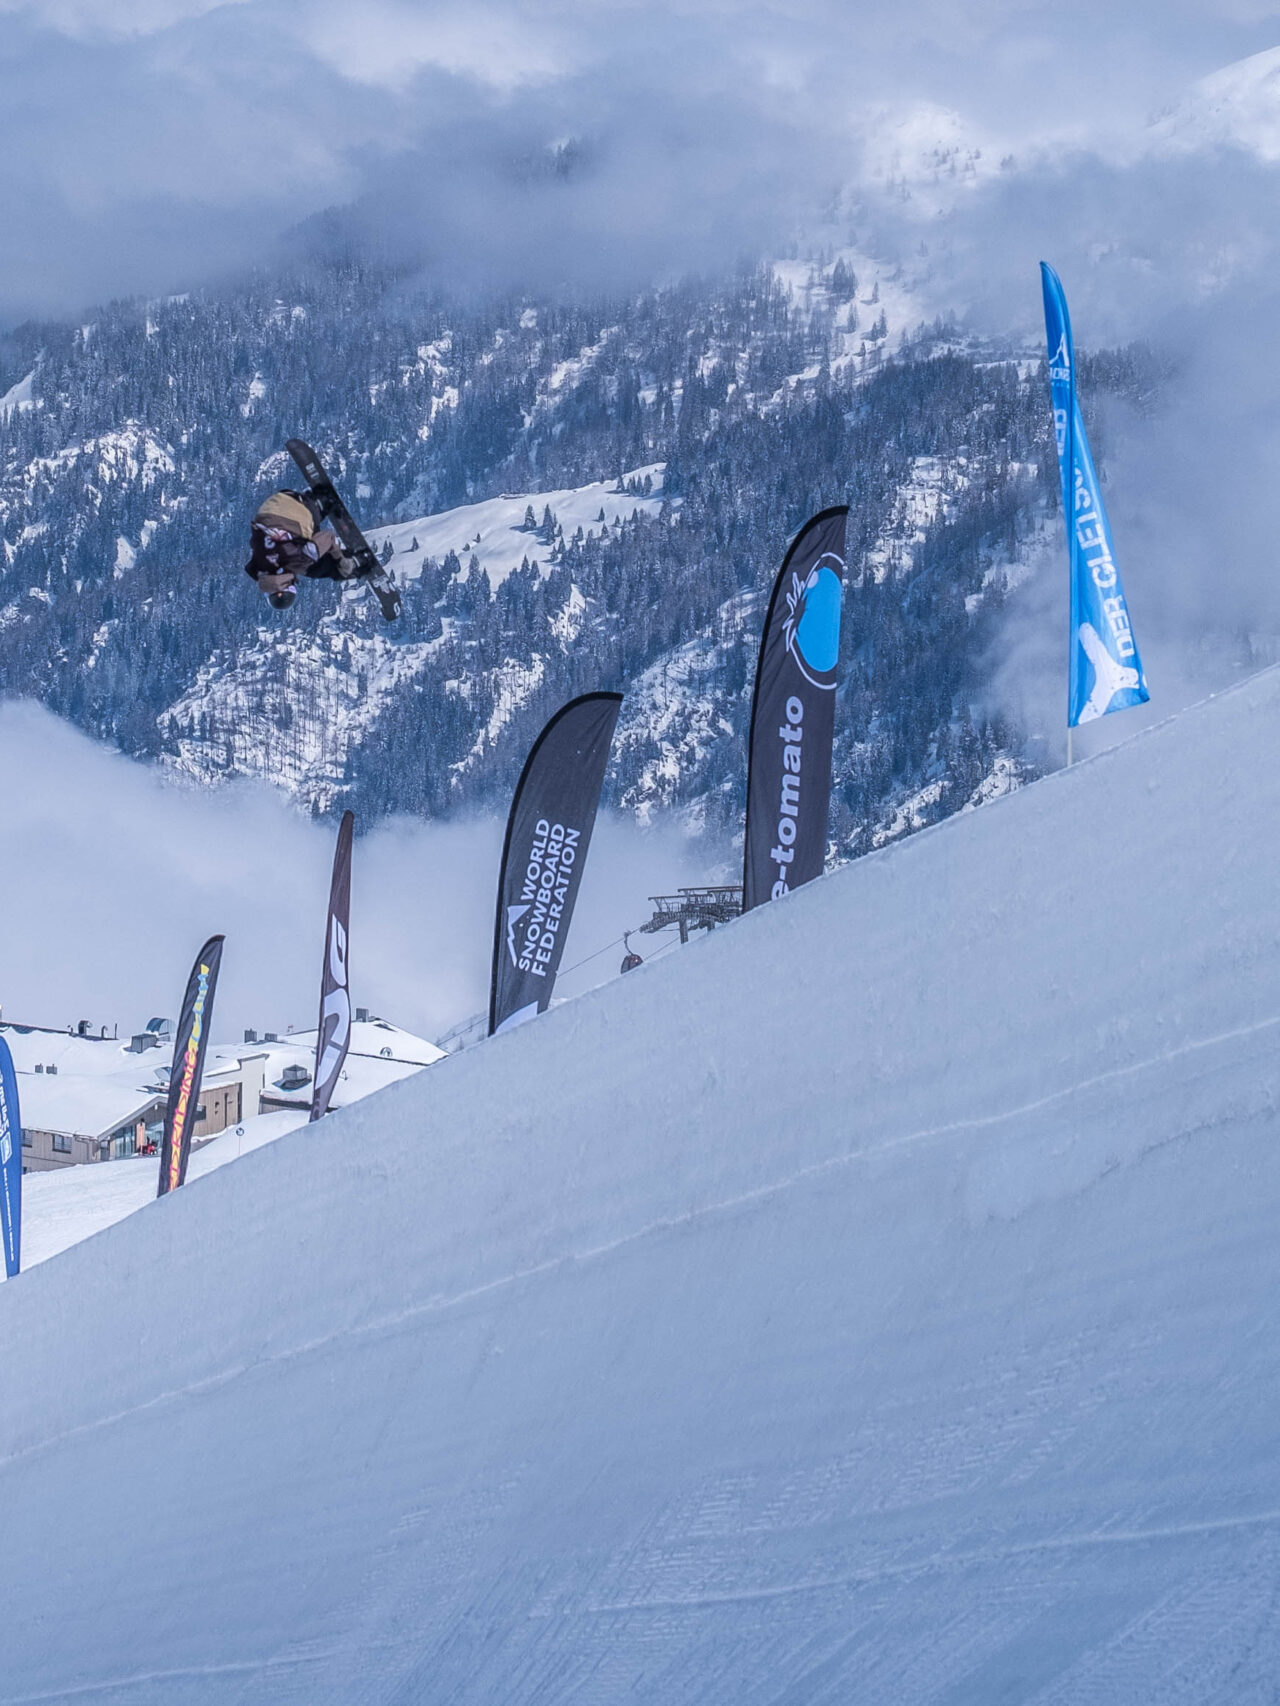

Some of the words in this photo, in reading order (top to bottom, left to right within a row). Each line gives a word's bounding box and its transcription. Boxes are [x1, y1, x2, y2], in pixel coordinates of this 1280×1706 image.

[1103, 594, 1139, 658] DER
[518, 823, 566, 973] SNOWBOARD
[520, 818, 551, 901] WORLD
[531, 828, 581, 977] FEDERATION
